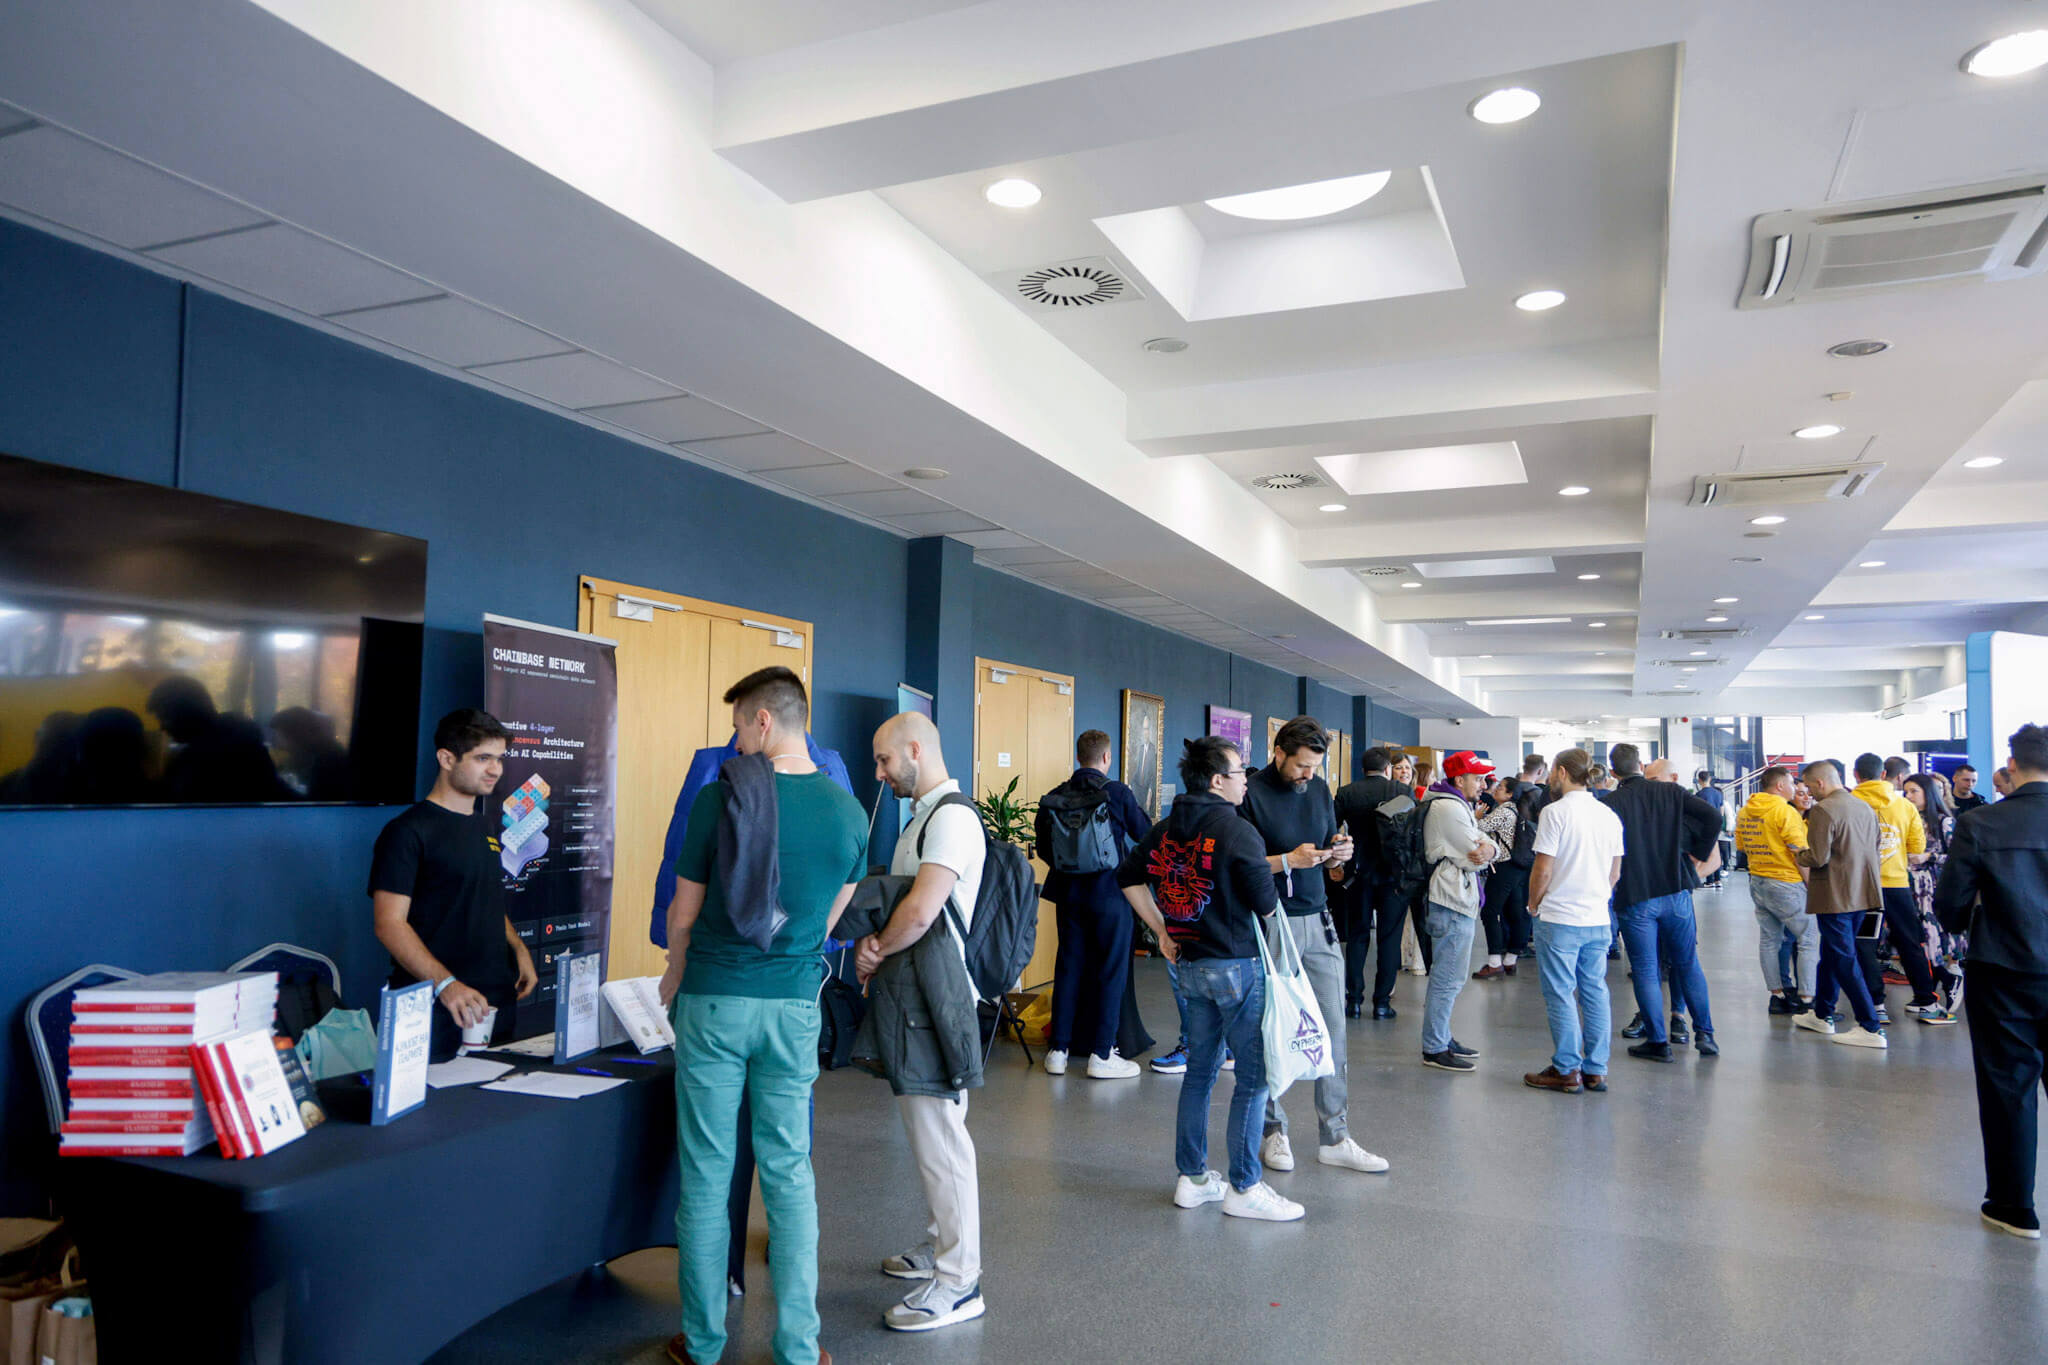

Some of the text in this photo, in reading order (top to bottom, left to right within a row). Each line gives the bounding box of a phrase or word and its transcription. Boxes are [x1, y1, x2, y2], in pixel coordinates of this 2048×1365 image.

[493, 648, 586, 674] CHAINBASE NETWORK
[543, 737, 584, 748] Architecture
[532, 750, 574, 761] Capabilities
